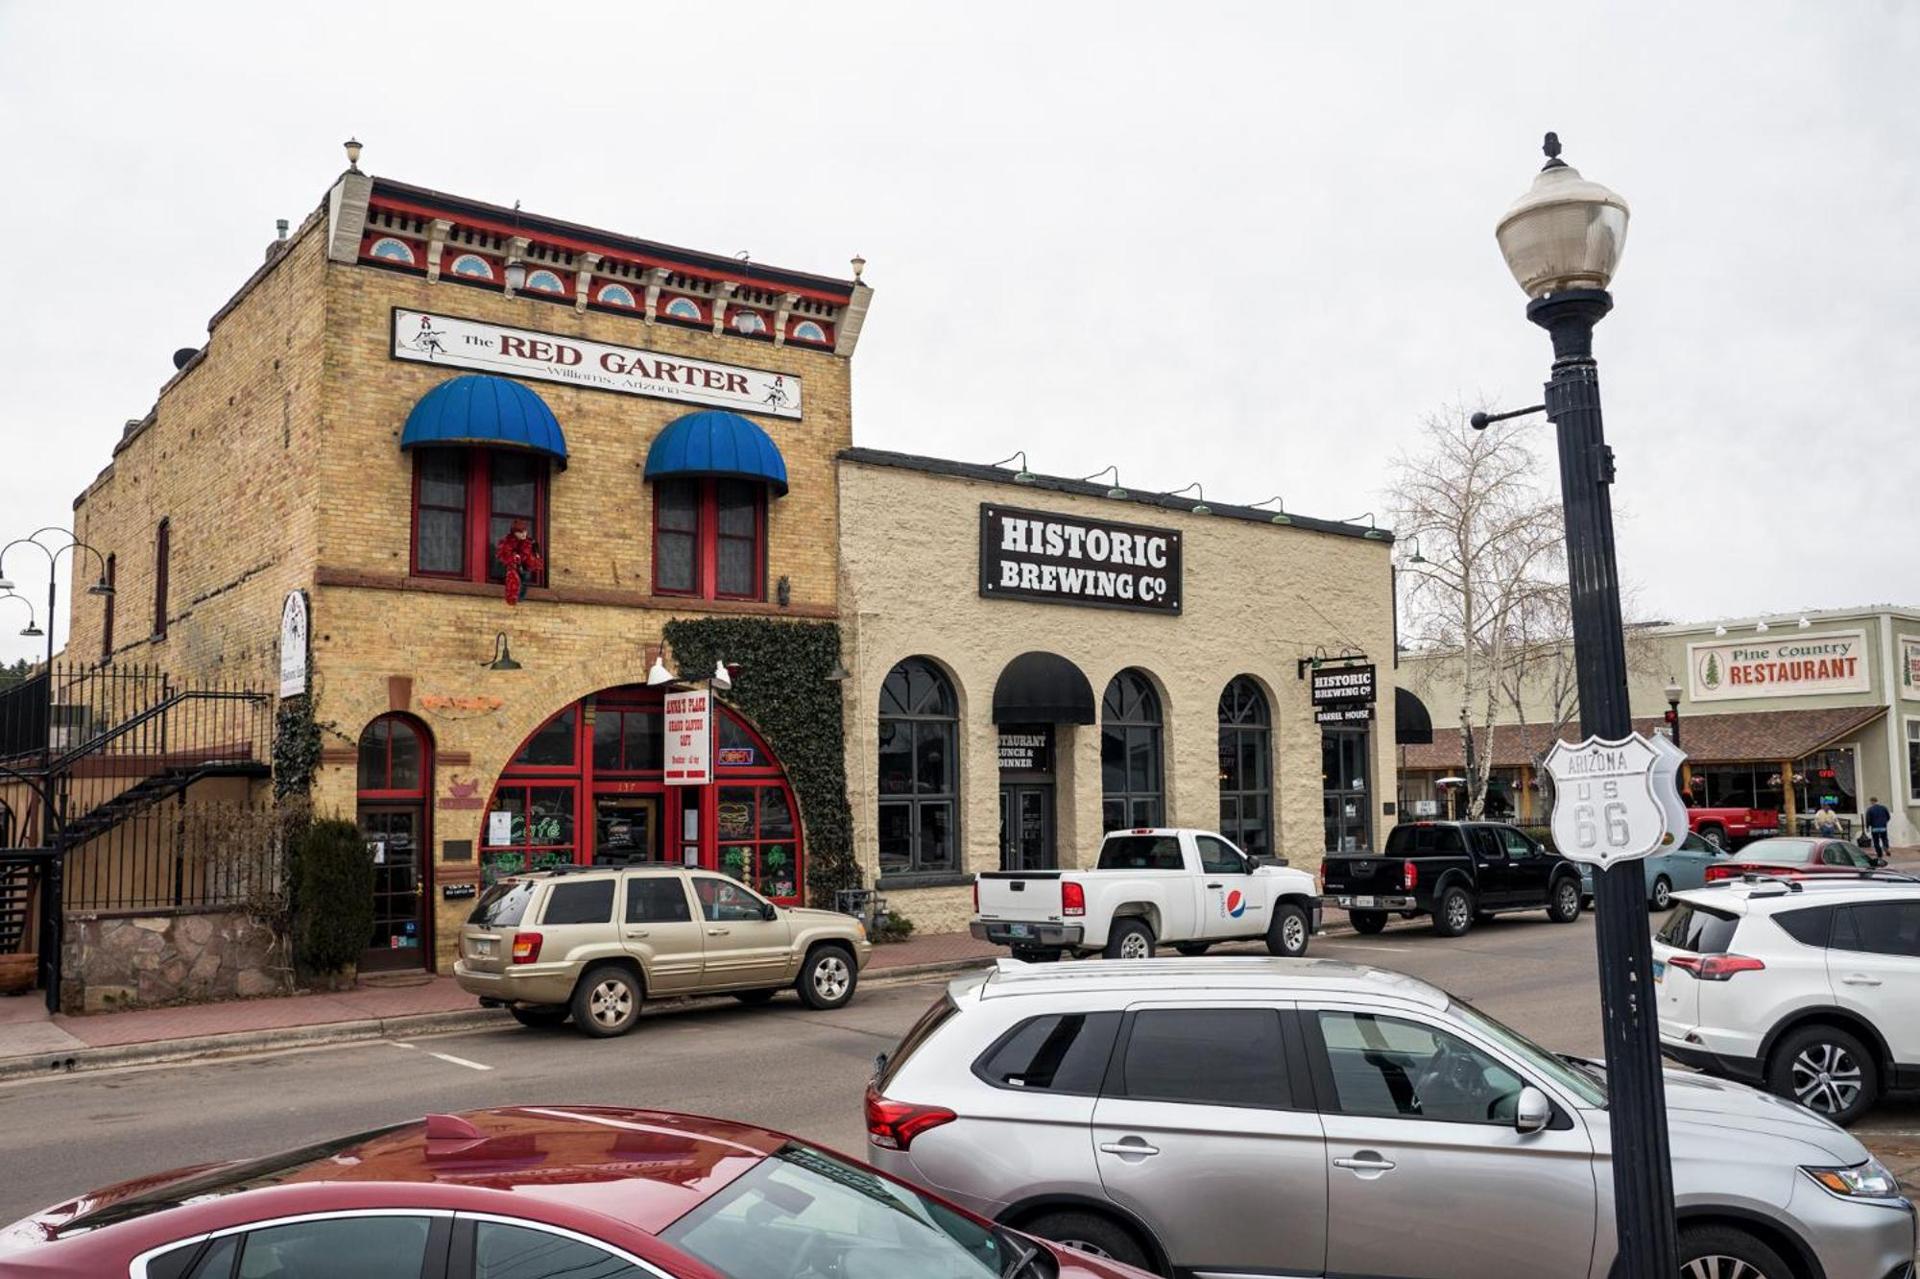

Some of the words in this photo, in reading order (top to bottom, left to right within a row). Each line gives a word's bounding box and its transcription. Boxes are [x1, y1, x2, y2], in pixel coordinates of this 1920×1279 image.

[462, 334, 494, 348] The
[499, 334, 583, 367] RED
[599, 352, 751, 395] GARTER
[622, 379, 680, 395] Arizona
[1000, 516, 1167, 568] HISTORIC
[1000, 560, 1134, 600] BREWING
[1732, 648, 1770, 661] Pine
[1777, 643, 1852, 657] Country
[1730, 657, 1858, 685] RESTAURANT
[1314, 673, 1371, 688] HISTORIC
[1314, 687, 1359, 698] BREWING
[1344, 710, 1369, 719] HOUSE
[999, 735, 1046, 747] TAURANT
[1027, 749, 1034, 757] &
[1568, 751, 1629, 775] ARIZONA
[1574, 801, 1631, 849] 66
